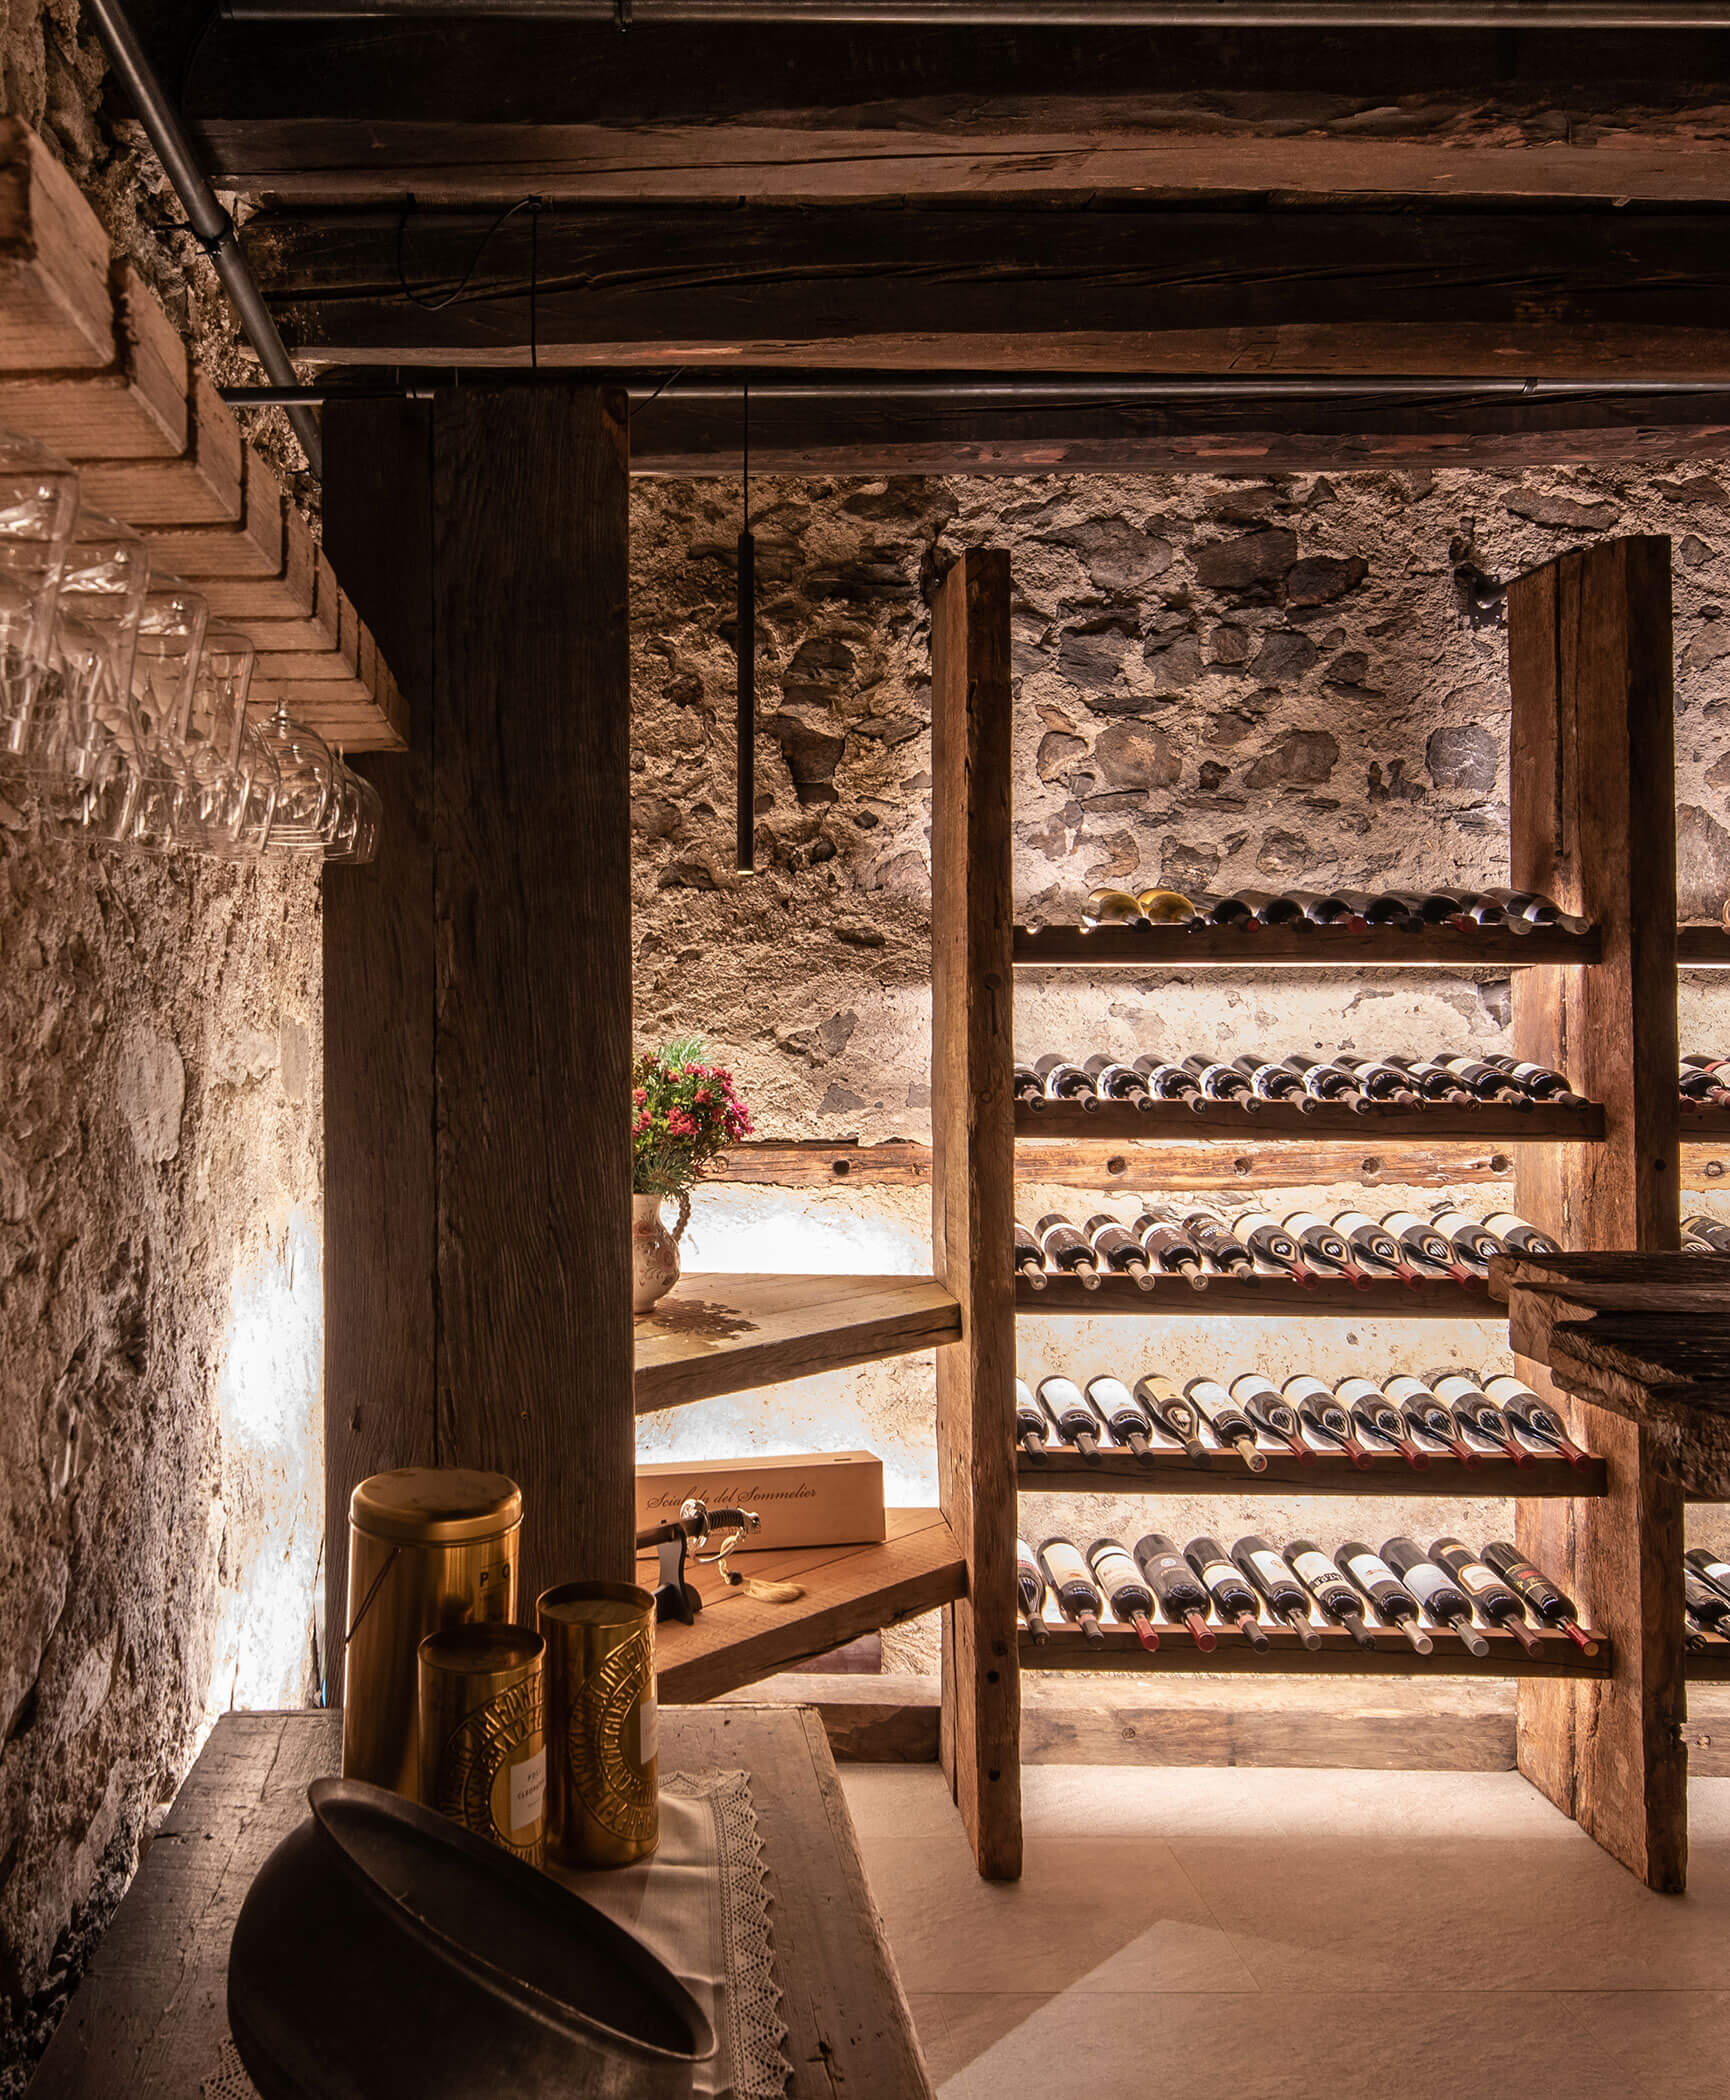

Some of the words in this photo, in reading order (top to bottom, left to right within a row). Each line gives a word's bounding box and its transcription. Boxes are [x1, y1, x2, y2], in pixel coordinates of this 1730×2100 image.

[648, 1486, 709, 1509] Sciabla
[713, 1487, 737, 1503] del
[739, 1484, 816, 1502] Sommelier
